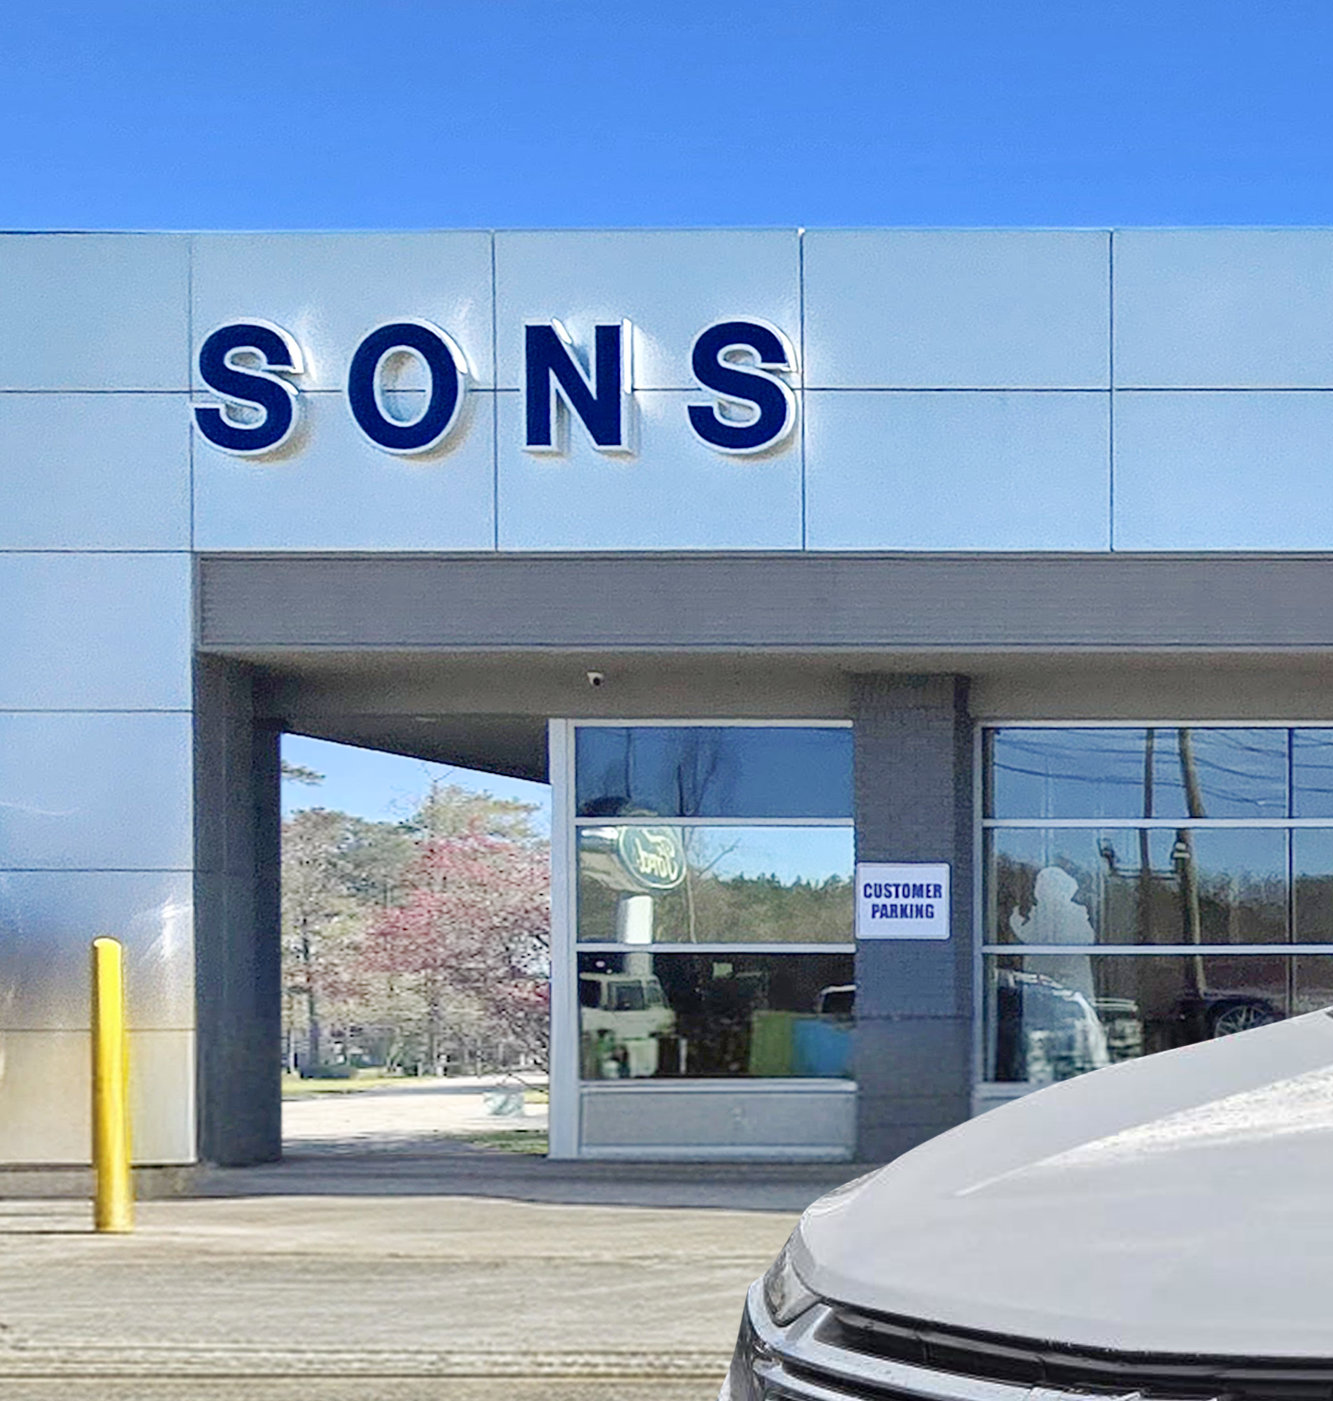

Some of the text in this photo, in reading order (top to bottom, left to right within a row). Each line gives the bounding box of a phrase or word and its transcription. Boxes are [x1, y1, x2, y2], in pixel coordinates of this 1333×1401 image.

[193, 320, 794, 454] SONS
[863, 882, 943, 899] CUSTOMER
[871, 903, 935, 919] PARKING
